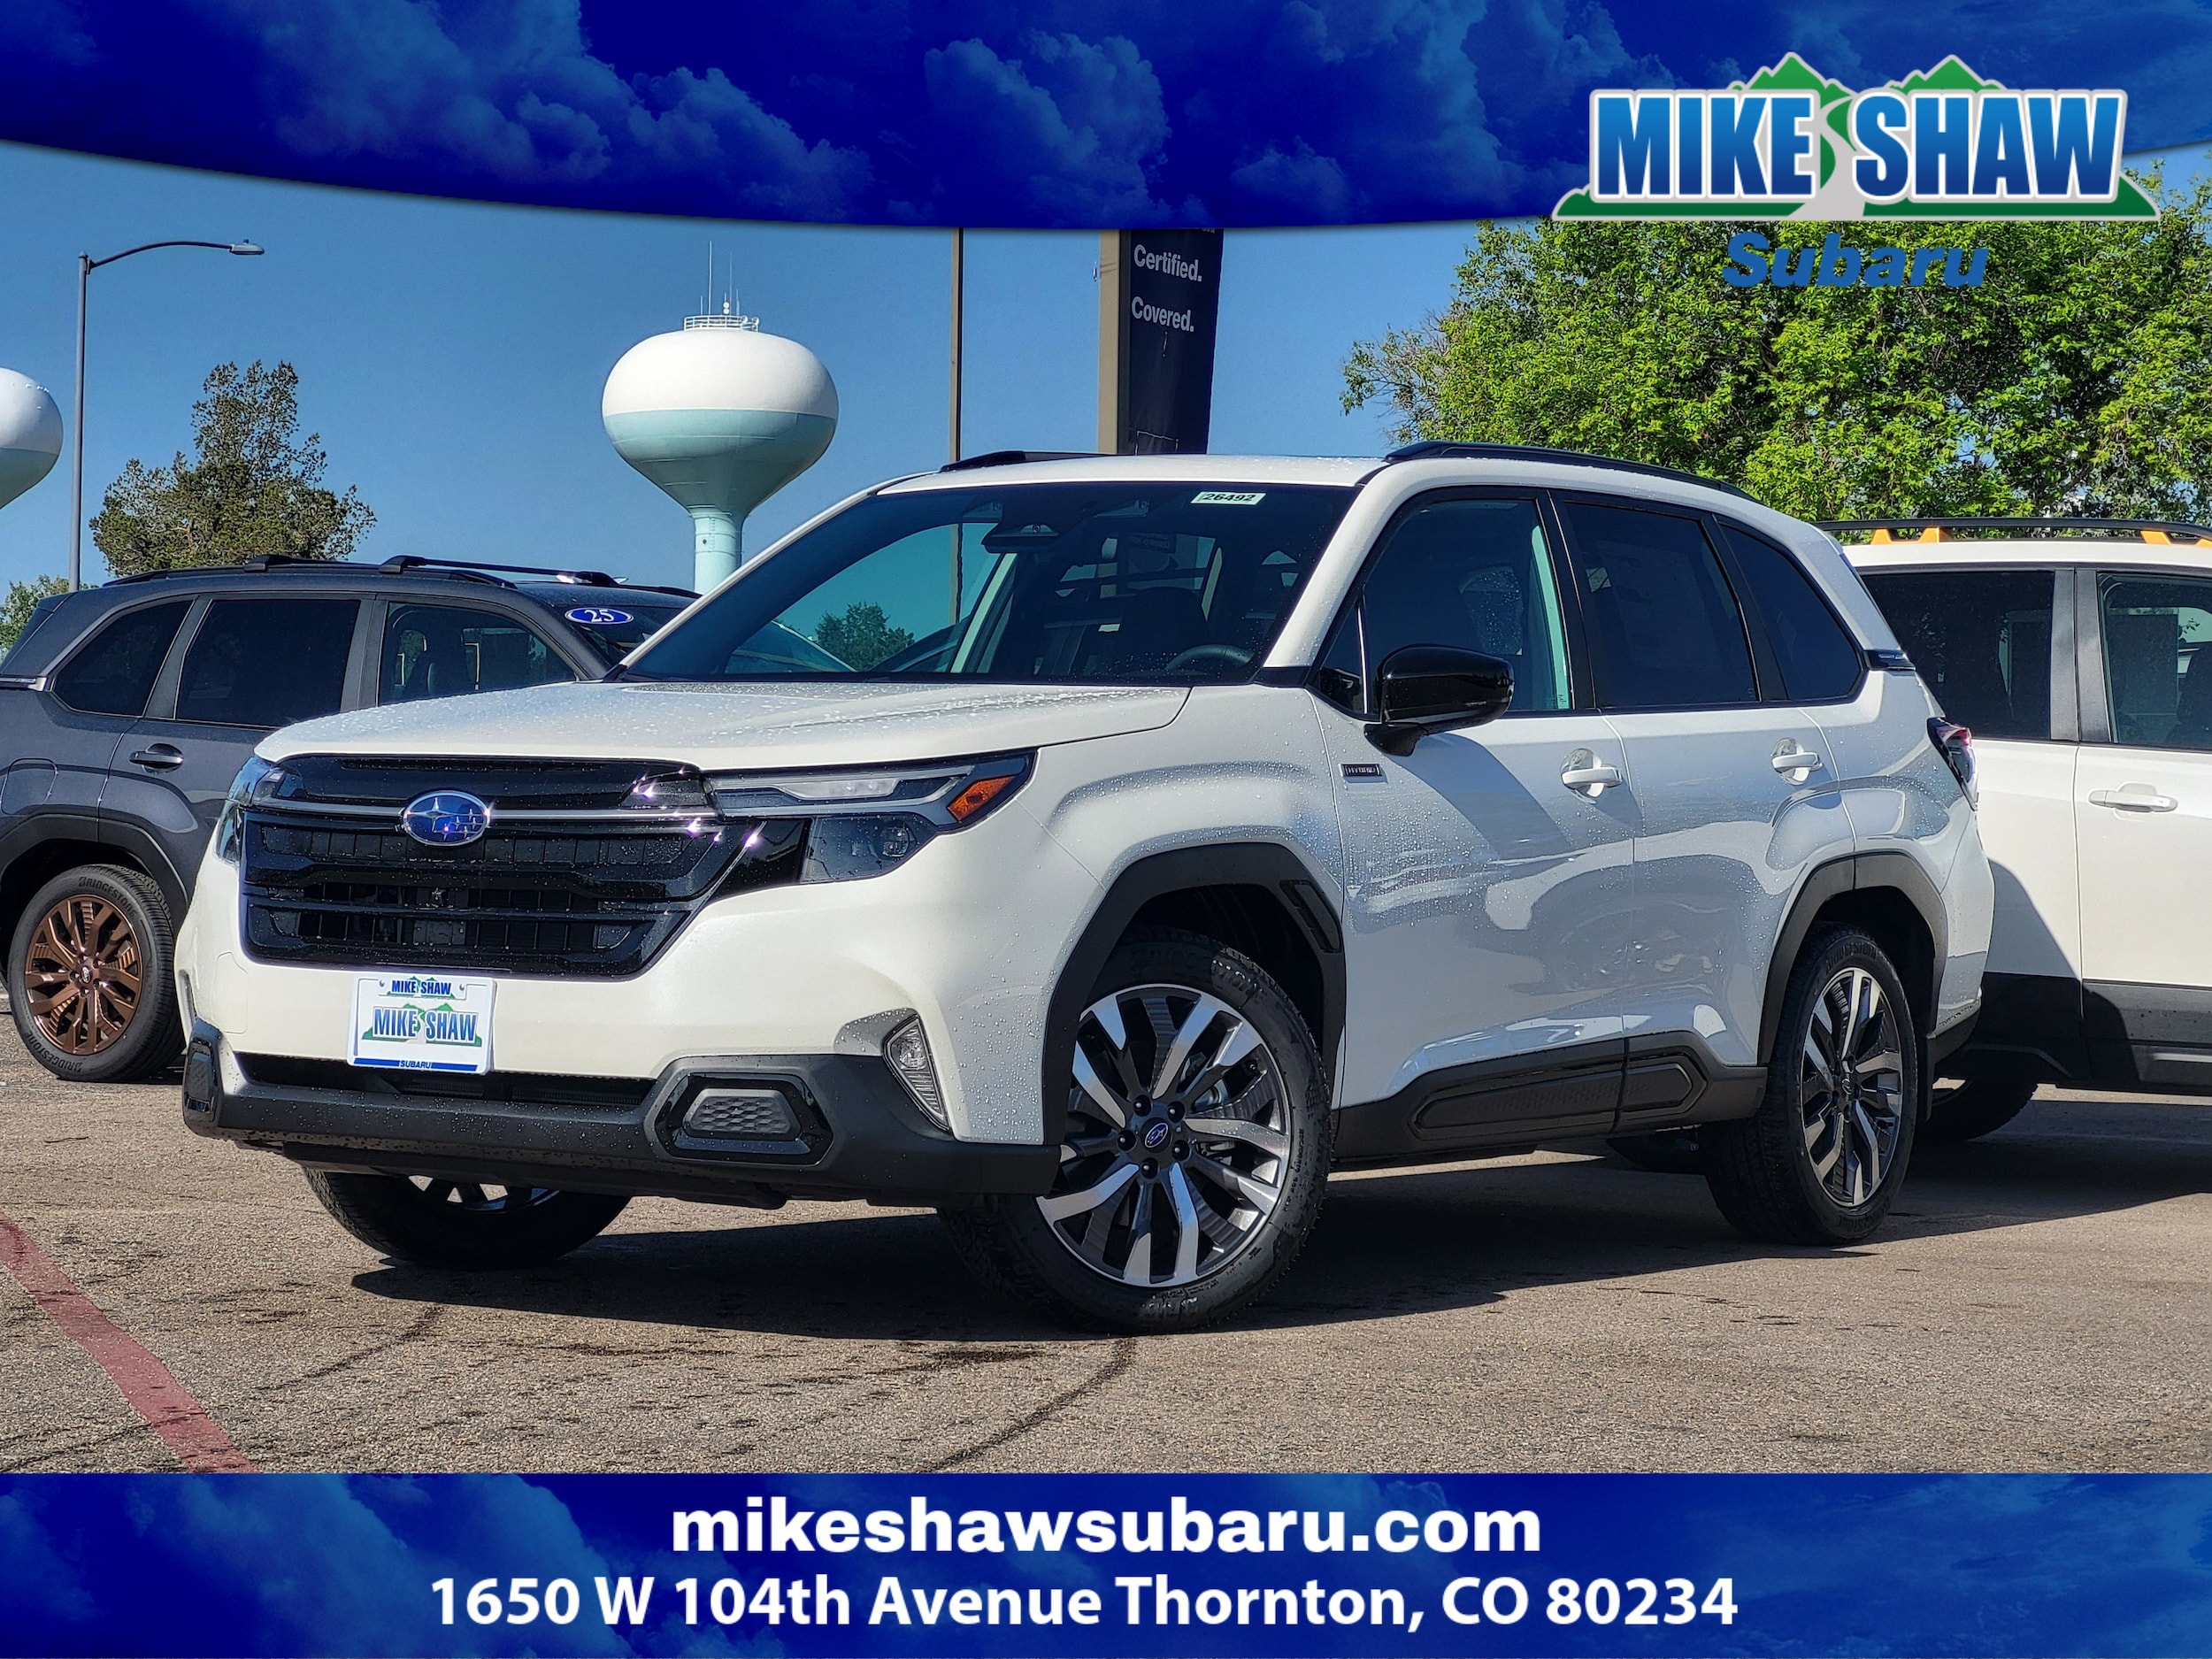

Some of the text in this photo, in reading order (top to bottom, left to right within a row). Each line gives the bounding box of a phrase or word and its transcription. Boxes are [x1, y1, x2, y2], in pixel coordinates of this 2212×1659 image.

[1133, 244, 1202, 282] Certified.
[1132, 296, 1194, 332] Covered.
[1202, 493, 1256, 502] 26492
[585, 609, 615, 622] 25
[79, 876, 137, 917] BRIDGESTONE
[391, 979, 452, 995] MIKE SHAW
[373, 1008, 477, 1042] MIKE SHAW
[26, 1031, 83, 1072] BRIDGESTONE
[400, 1060, 432, 1069] SUBARU
